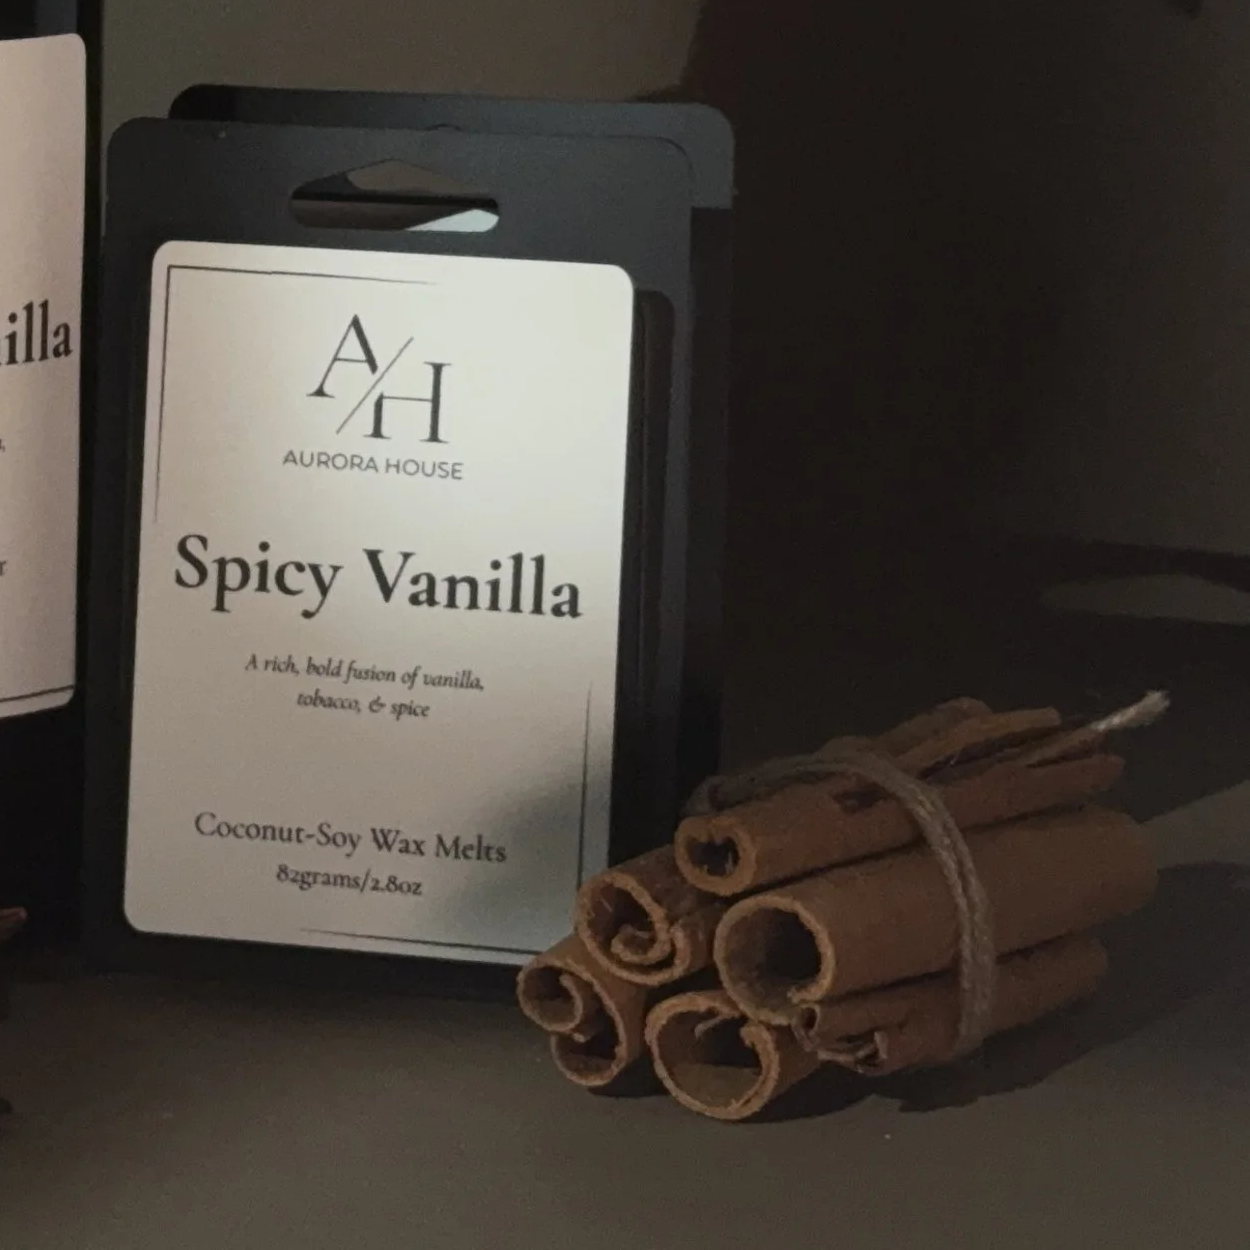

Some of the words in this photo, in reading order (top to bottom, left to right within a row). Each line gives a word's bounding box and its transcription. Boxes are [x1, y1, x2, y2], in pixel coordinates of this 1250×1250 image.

[282, 450, 379, 473] AURORA
[385, 458, 463, 480] HOUSE
[175, 534, 343, 619] Spicy
[364, 549, 581, 618] Vanilla
[245, 654, 258, 671] A
[306, 656, 342, 678] bold
[345, 660, 396, 684] fusion
[400, 665, 422, 690] of
[368, 695, 386, 713] &
[391, 700, 430, 721] spice
[194, 812, 362, 857] Coconut-Soy
[370, 828, 426, 856] Wax
[435, 834, 507, 862] Melts
[276, 864, 422, 896] 82grams/2.8oz
